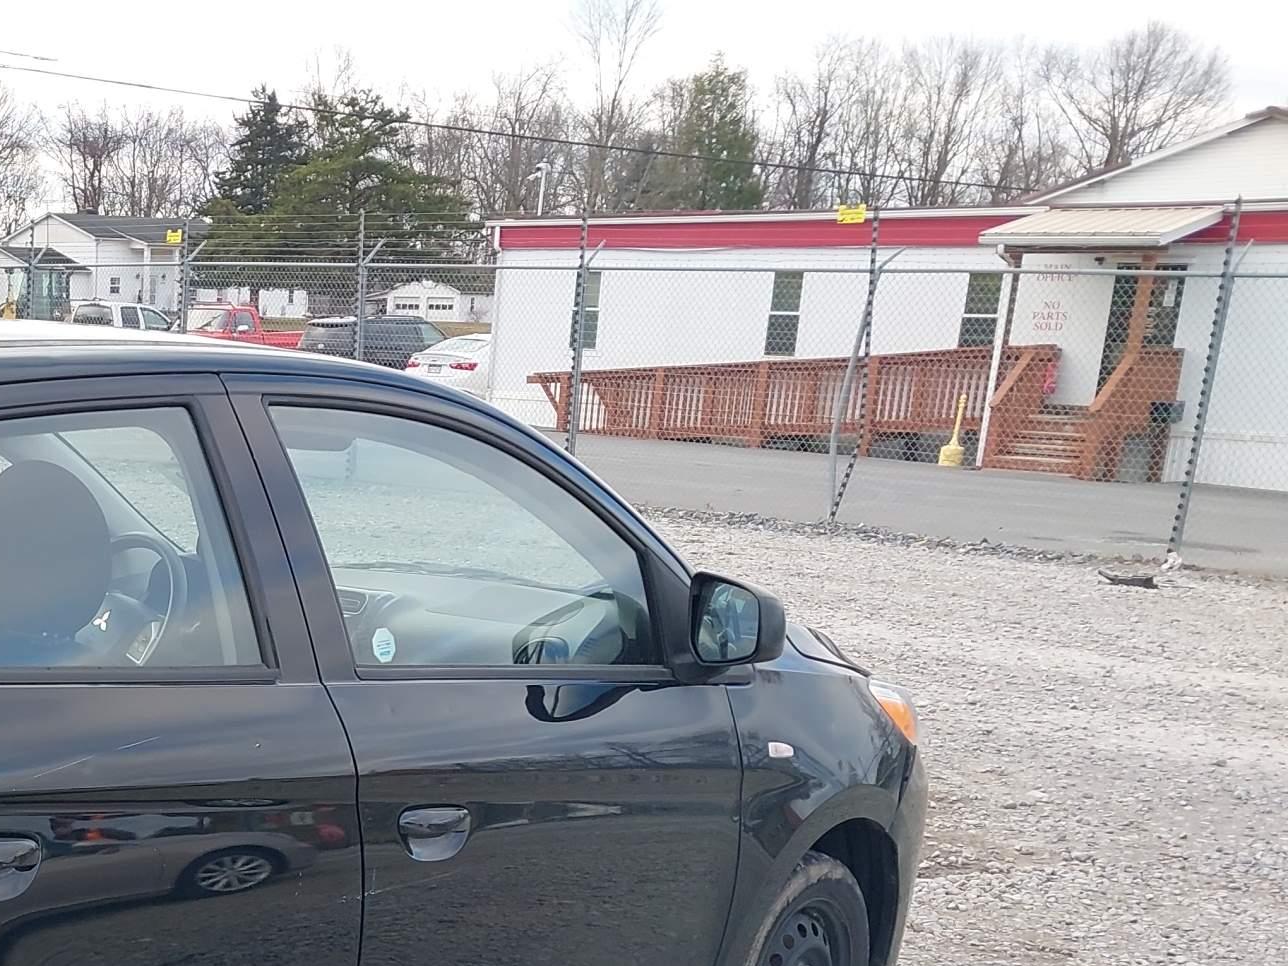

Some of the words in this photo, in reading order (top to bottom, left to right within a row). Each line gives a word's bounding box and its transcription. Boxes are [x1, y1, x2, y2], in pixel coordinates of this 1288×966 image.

[1043, 301, 1061, 310] NO
[1032, 311, 1068, 320] PARTS
[1032, 321, 1063, 331] SOLD
